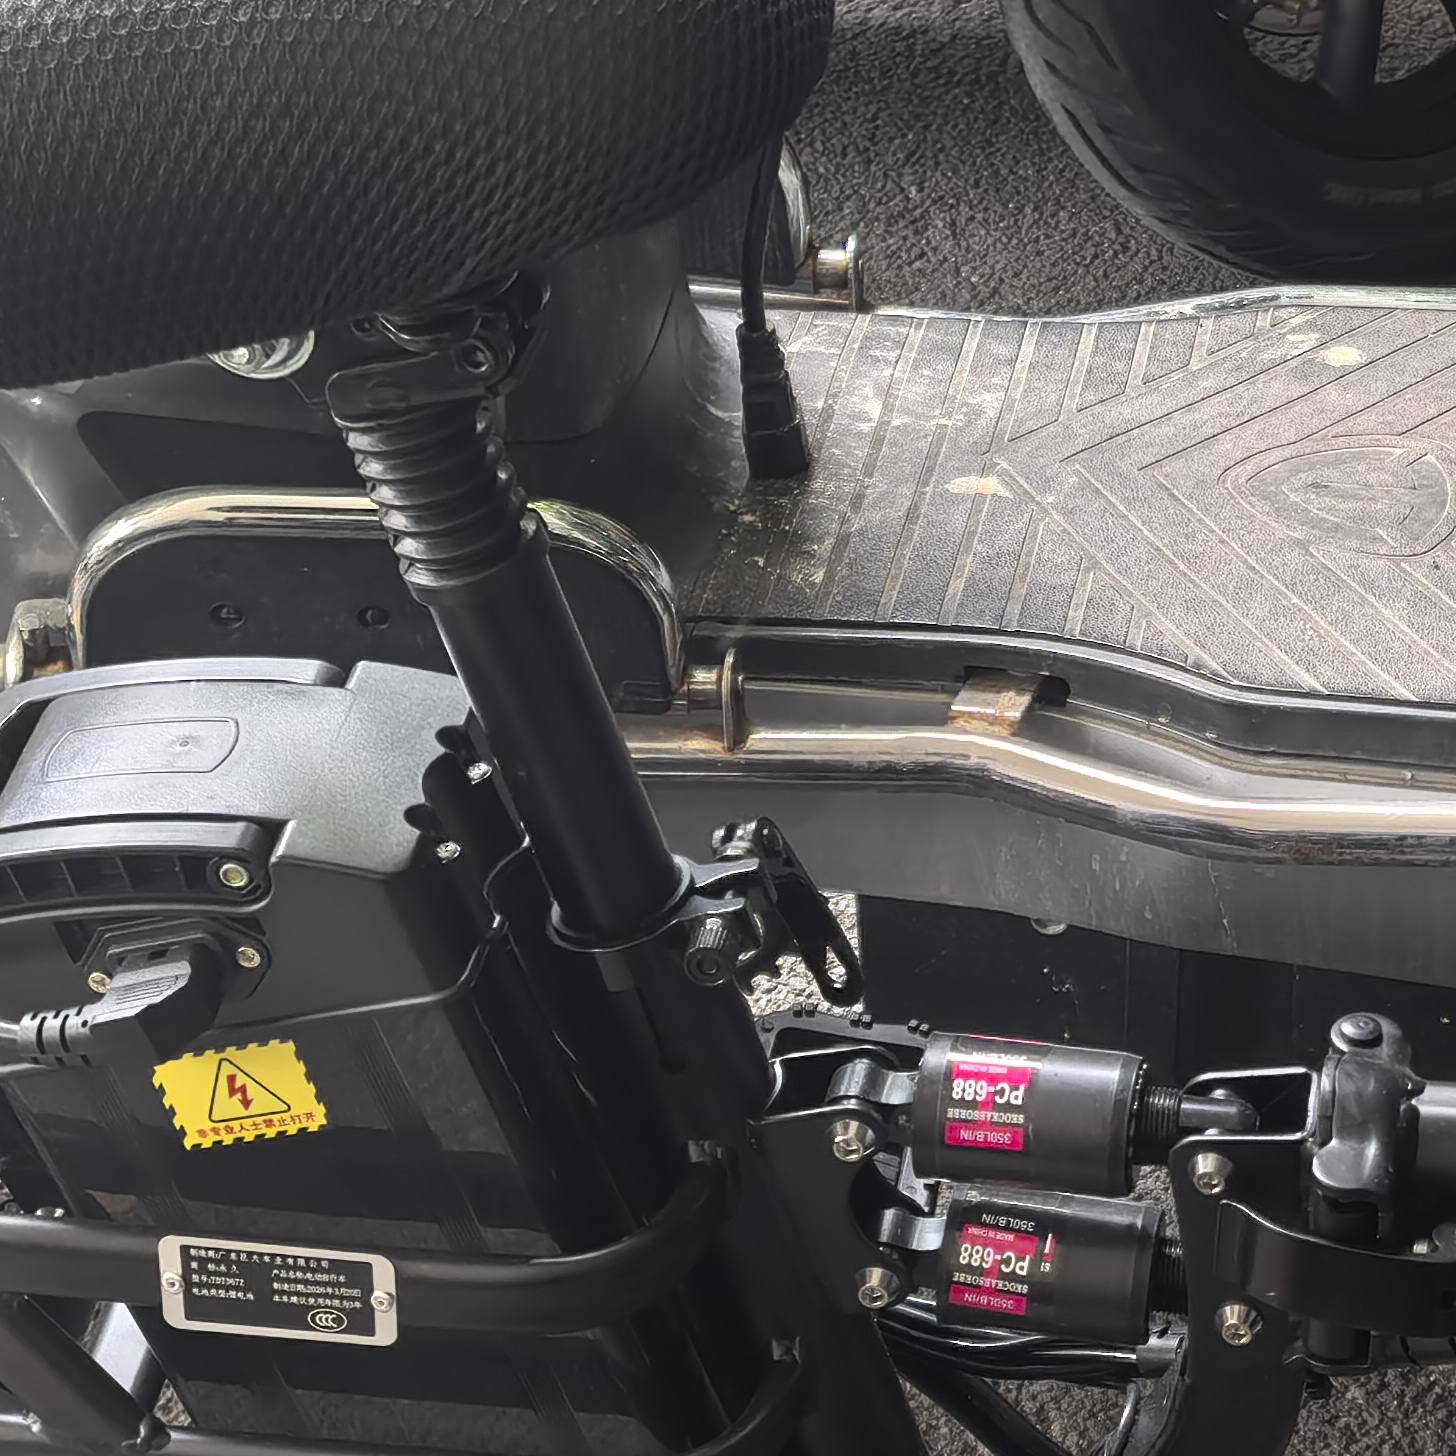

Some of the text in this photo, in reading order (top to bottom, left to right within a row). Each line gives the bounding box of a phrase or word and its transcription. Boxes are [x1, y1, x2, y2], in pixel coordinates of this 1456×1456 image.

[952, 1078, 1025, 1105] PC-688
[195, 1111, 316, 1139] 非专业人士禁止打开
[959, 1129, 1012, 1144] 350LB/IN
[981, 1213, 1036, 1232] 350LB/IN
[959, 1243, 1031, 1276] PC-688
